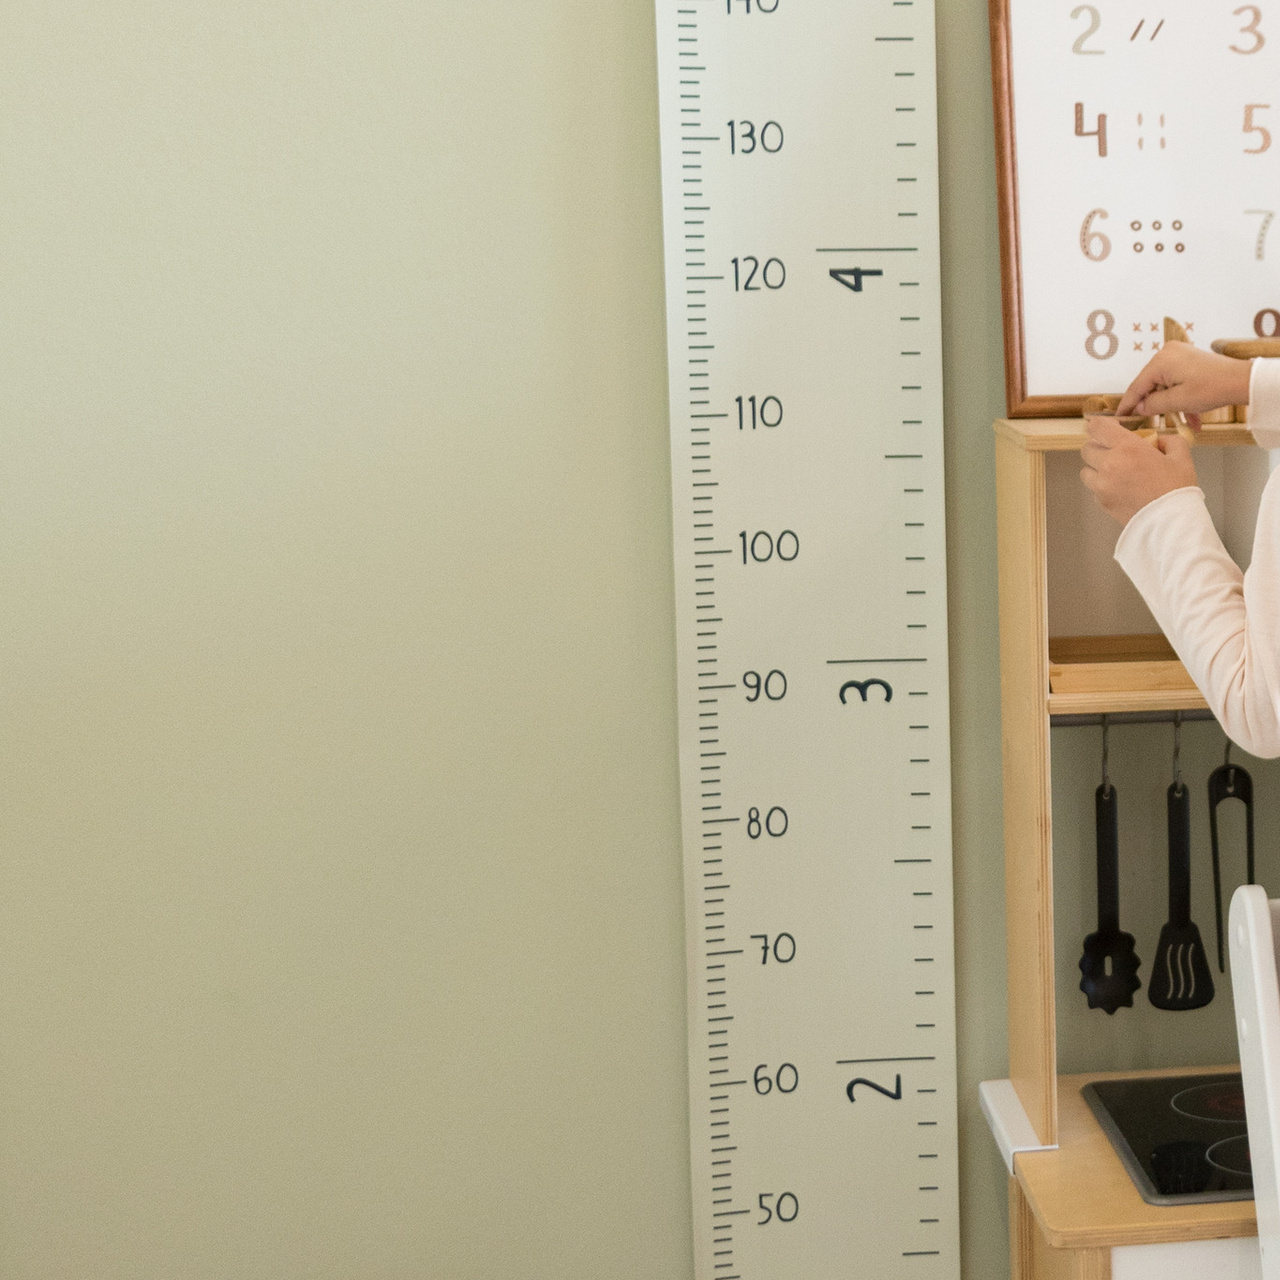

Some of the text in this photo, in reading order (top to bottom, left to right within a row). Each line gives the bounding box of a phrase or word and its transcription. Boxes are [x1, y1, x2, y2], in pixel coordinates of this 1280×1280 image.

[1069, 4, 1106, 56] 2
[1228, 4, 1266, 56] 3
[726, 119, 784, 155] 130
[1073, 101, 1108, 158] 4
[1241, 103, 1273, 155] 5
[1079, 208, 1112, 263] 6
[1243, 209, 1276, 262] 7
[730, 255, 787, 292] 120
[828, 266, 884, 293] 4
[1084, 308, 1120, 361] 8
[734, 395, 784, 431] 110
[738, 529, 800, 565] 100
[742, 669, 788, 703] 90
[838, 678, 893, 705] 3
[746, 805, 789, 840] 80
[749, 932, 797, 966] 70
[753, 1062, 799, 1096] 60
[845, 1073, 903, 1104] 2
[757, 1191, 800, 1226] 50
